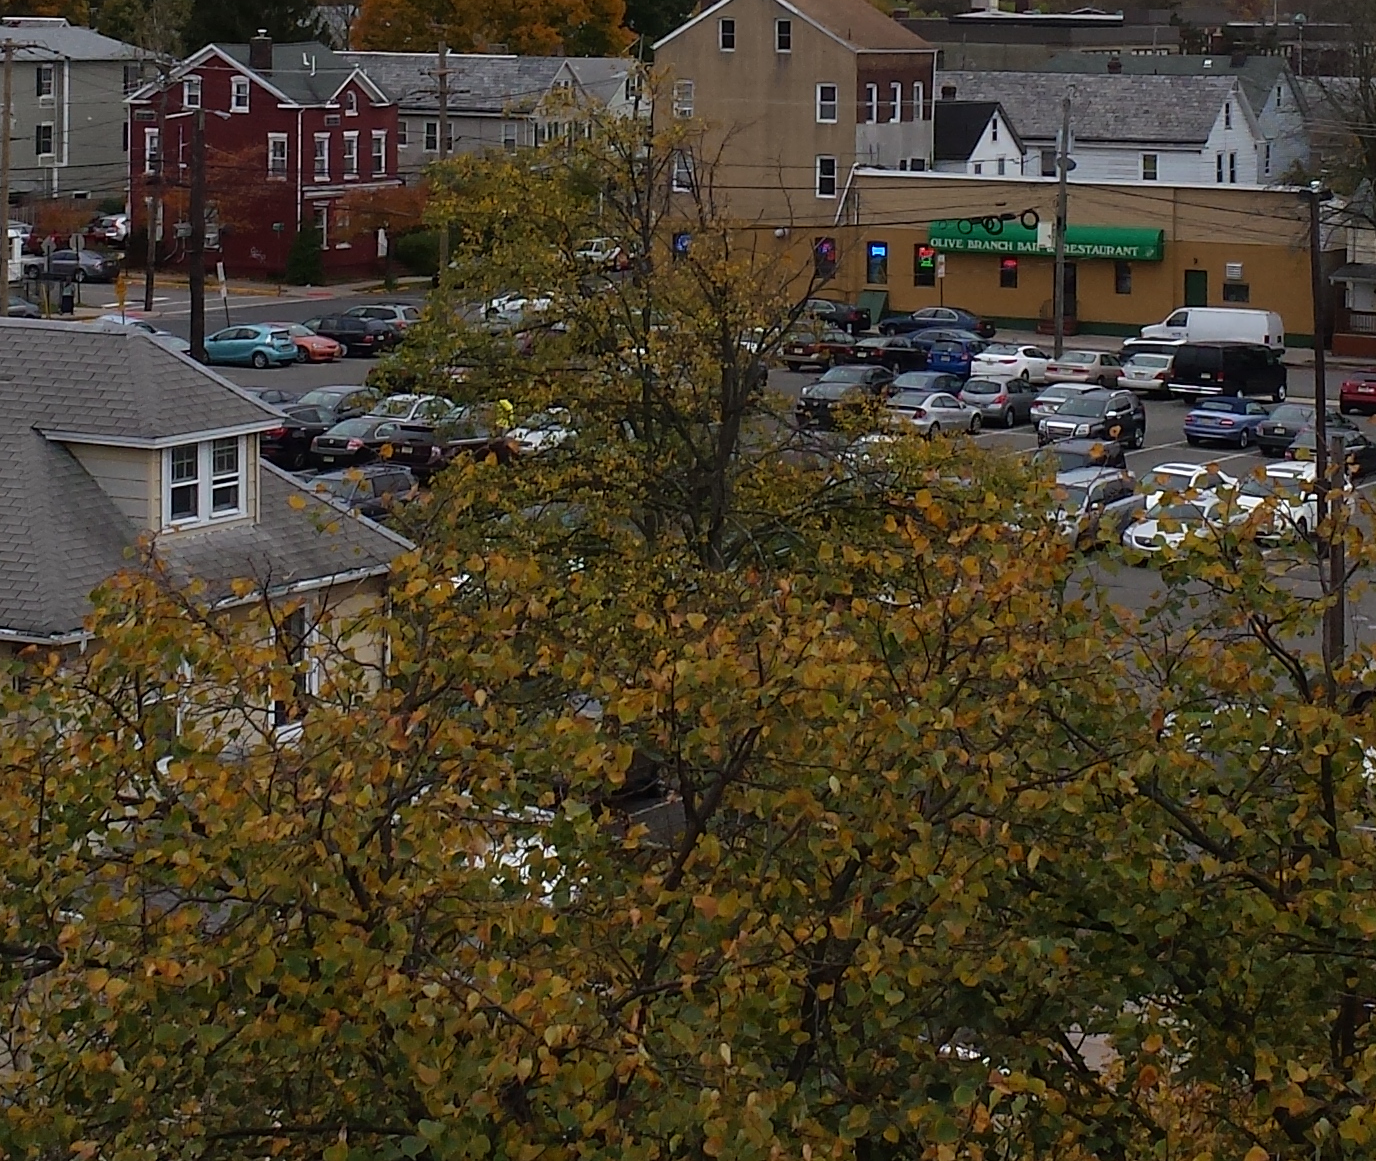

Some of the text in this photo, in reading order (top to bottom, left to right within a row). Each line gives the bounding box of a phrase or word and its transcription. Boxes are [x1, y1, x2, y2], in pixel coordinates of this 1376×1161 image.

[930, 238, 963, 249] OLIVE
[967, 240, 1013, 251] BRANCH
[1017, 242, 1041, 252] BAR
[1063, 244, 1140, 257] RESTAURANT
